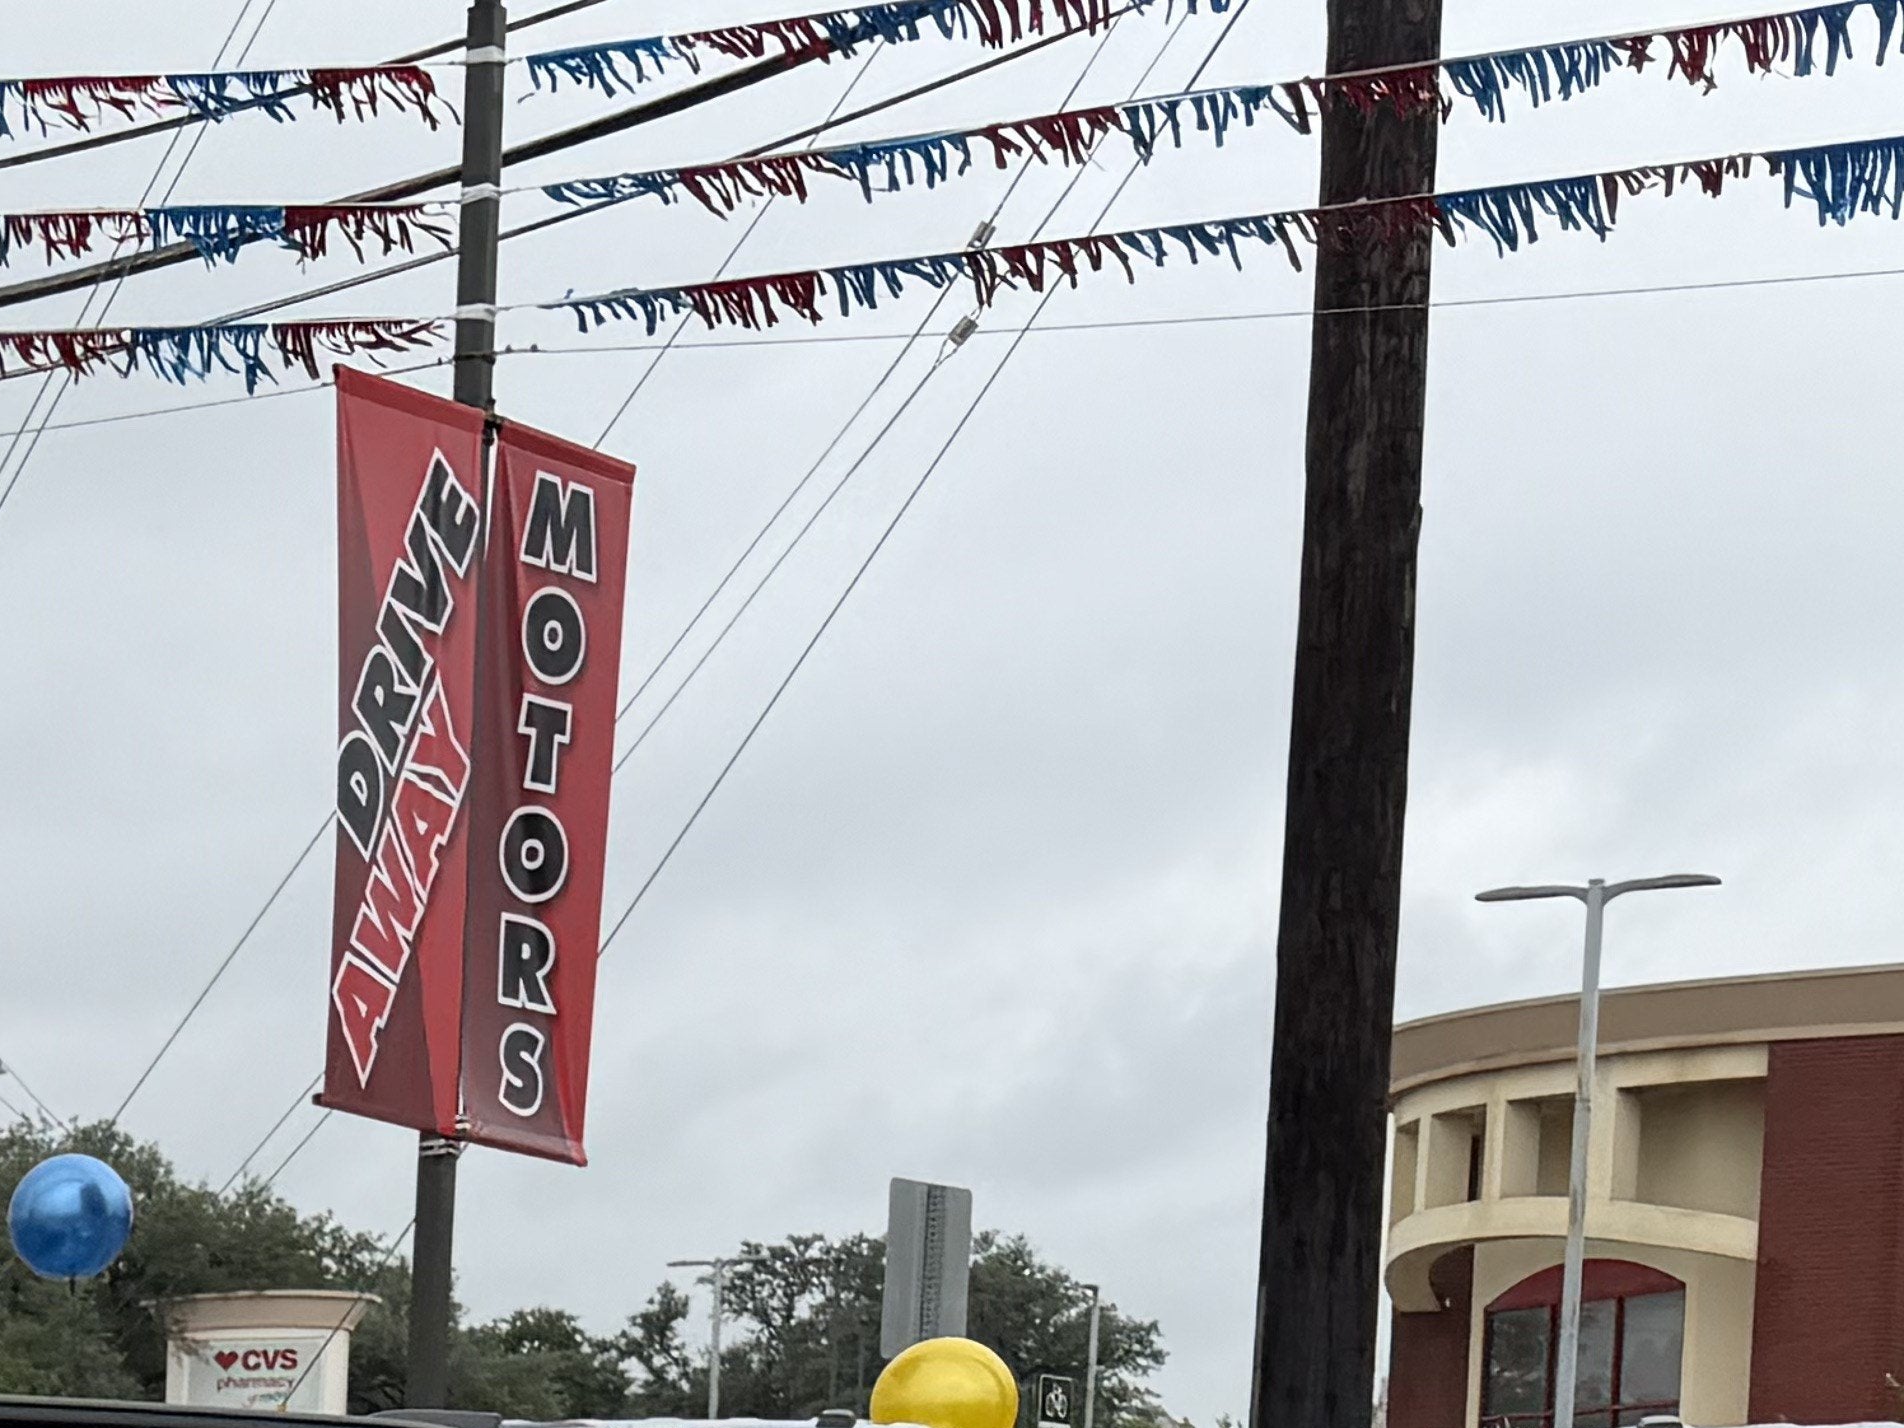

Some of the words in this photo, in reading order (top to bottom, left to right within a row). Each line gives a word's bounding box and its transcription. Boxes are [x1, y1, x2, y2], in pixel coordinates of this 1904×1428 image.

[336, 446, 480, 862] DRIVE
[498, 469, 598, 1118] MOTORS
[332, 668, 472, 1090] AWAY
[216, 1376, 294, 1393] pharmacy
[241, 1348, 298, 1372] CVS
